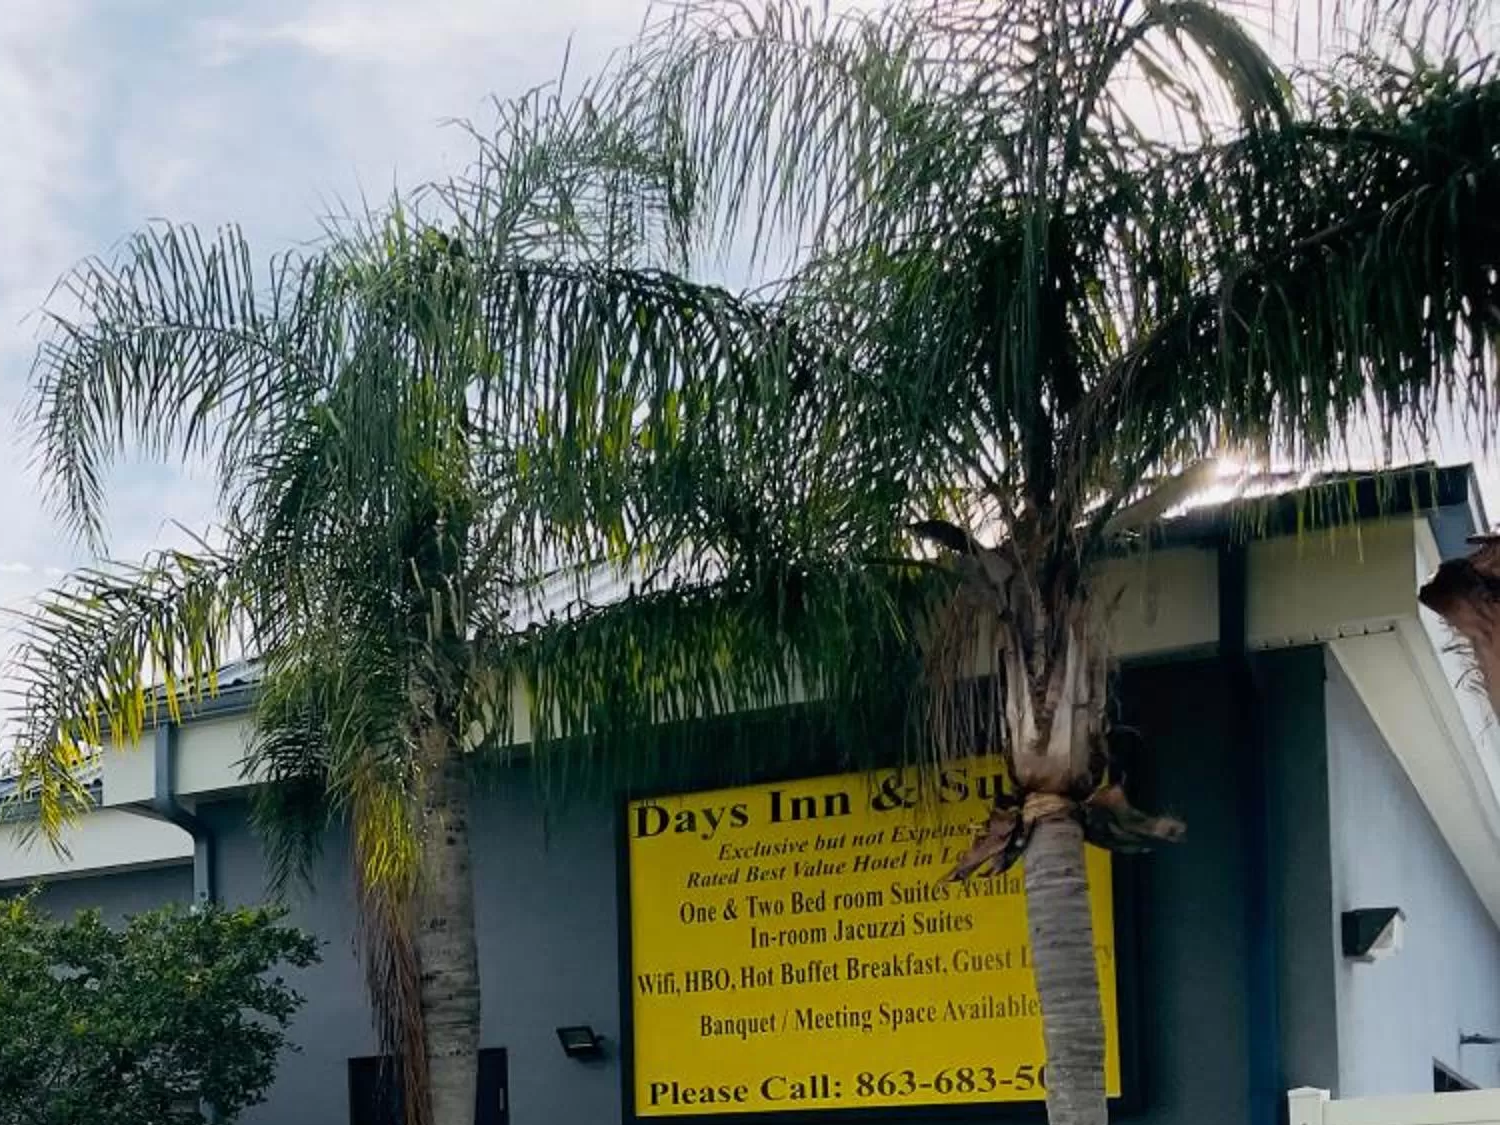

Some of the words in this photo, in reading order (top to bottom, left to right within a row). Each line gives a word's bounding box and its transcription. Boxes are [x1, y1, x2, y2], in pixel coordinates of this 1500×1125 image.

[632, 802, 749, 841] Days
[768, 790, 852, 824] Inn
[871, 773, 917, 812] &
[719, 840, 809, 861] Exclusive
[815, 832, 845, 851] but
[852, 831, 884, 847] not
[687, 868, 740, 889] Rated
[746, 865, 786, 883] Best
[793, 859, 846, 878] Value
[853, 850, 906, 873] Hotel
[913, 852, 933, 866] in
[679, 901, 717, 925] One
[723, 898, 738, 921] &
[747, 894, 785, 918] Two
[791, 889, 826, 914] Bed
[833, 889, 884, 911] room
[890, 879, 950, 906] Suites
[750, 925, 827, 948] In-room
[833, 913, 905, 942] Jacuzzi
[913, 911, 974, 935] Suites
[638, 972, 681, 996] Wifi,
[741, 964, 774, 988] Hot
[781, 959, 839, 985] Buffet
[953, 949, 1012, 972] Guest
[700, 1011, 777, 1040] Banquet
[781, 1008, 790, 1033] /
[795, 1004, 873, 1032] Meeting
[879, 1003, 937, 1031] Space
[649, 1080, 749, 1106] Please
[760, 1074, 842, 1101] Call:
